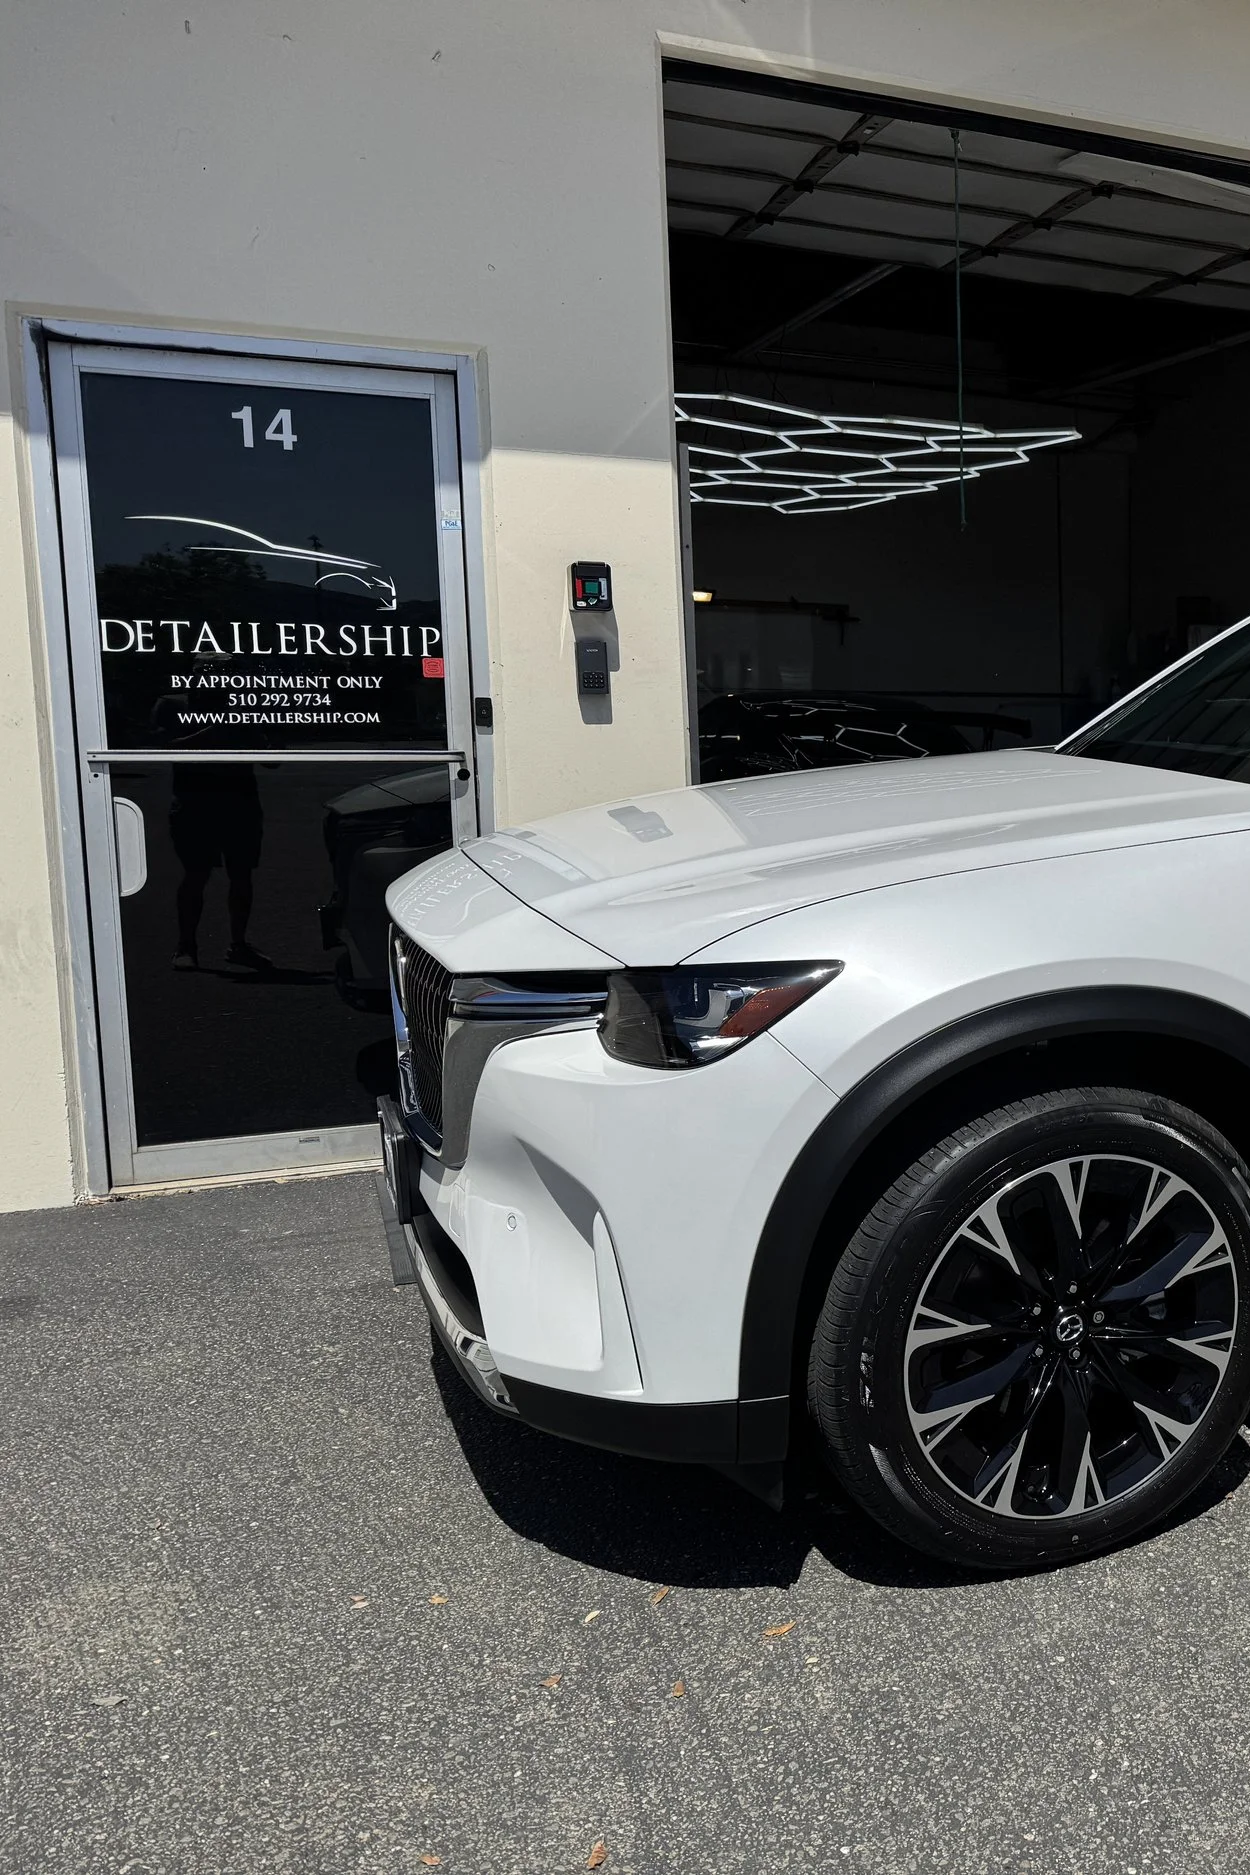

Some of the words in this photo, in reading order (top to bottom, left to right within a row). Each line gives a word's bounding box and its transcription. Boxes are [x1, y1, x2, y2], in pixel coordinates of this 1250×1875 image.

[231, 405, 298, 451] 14
[100, 618, 441, 658] DETAILERSHIP
[171, 675, 194, 689] BY
[196, 675, 331, 689] APPOINTMENT
[336, 675, 384, 690] ONLY
[228, 693, 258, 707] 510
[260, 693, 291, 707] 292
[293, 693, 332, 707] 9734
